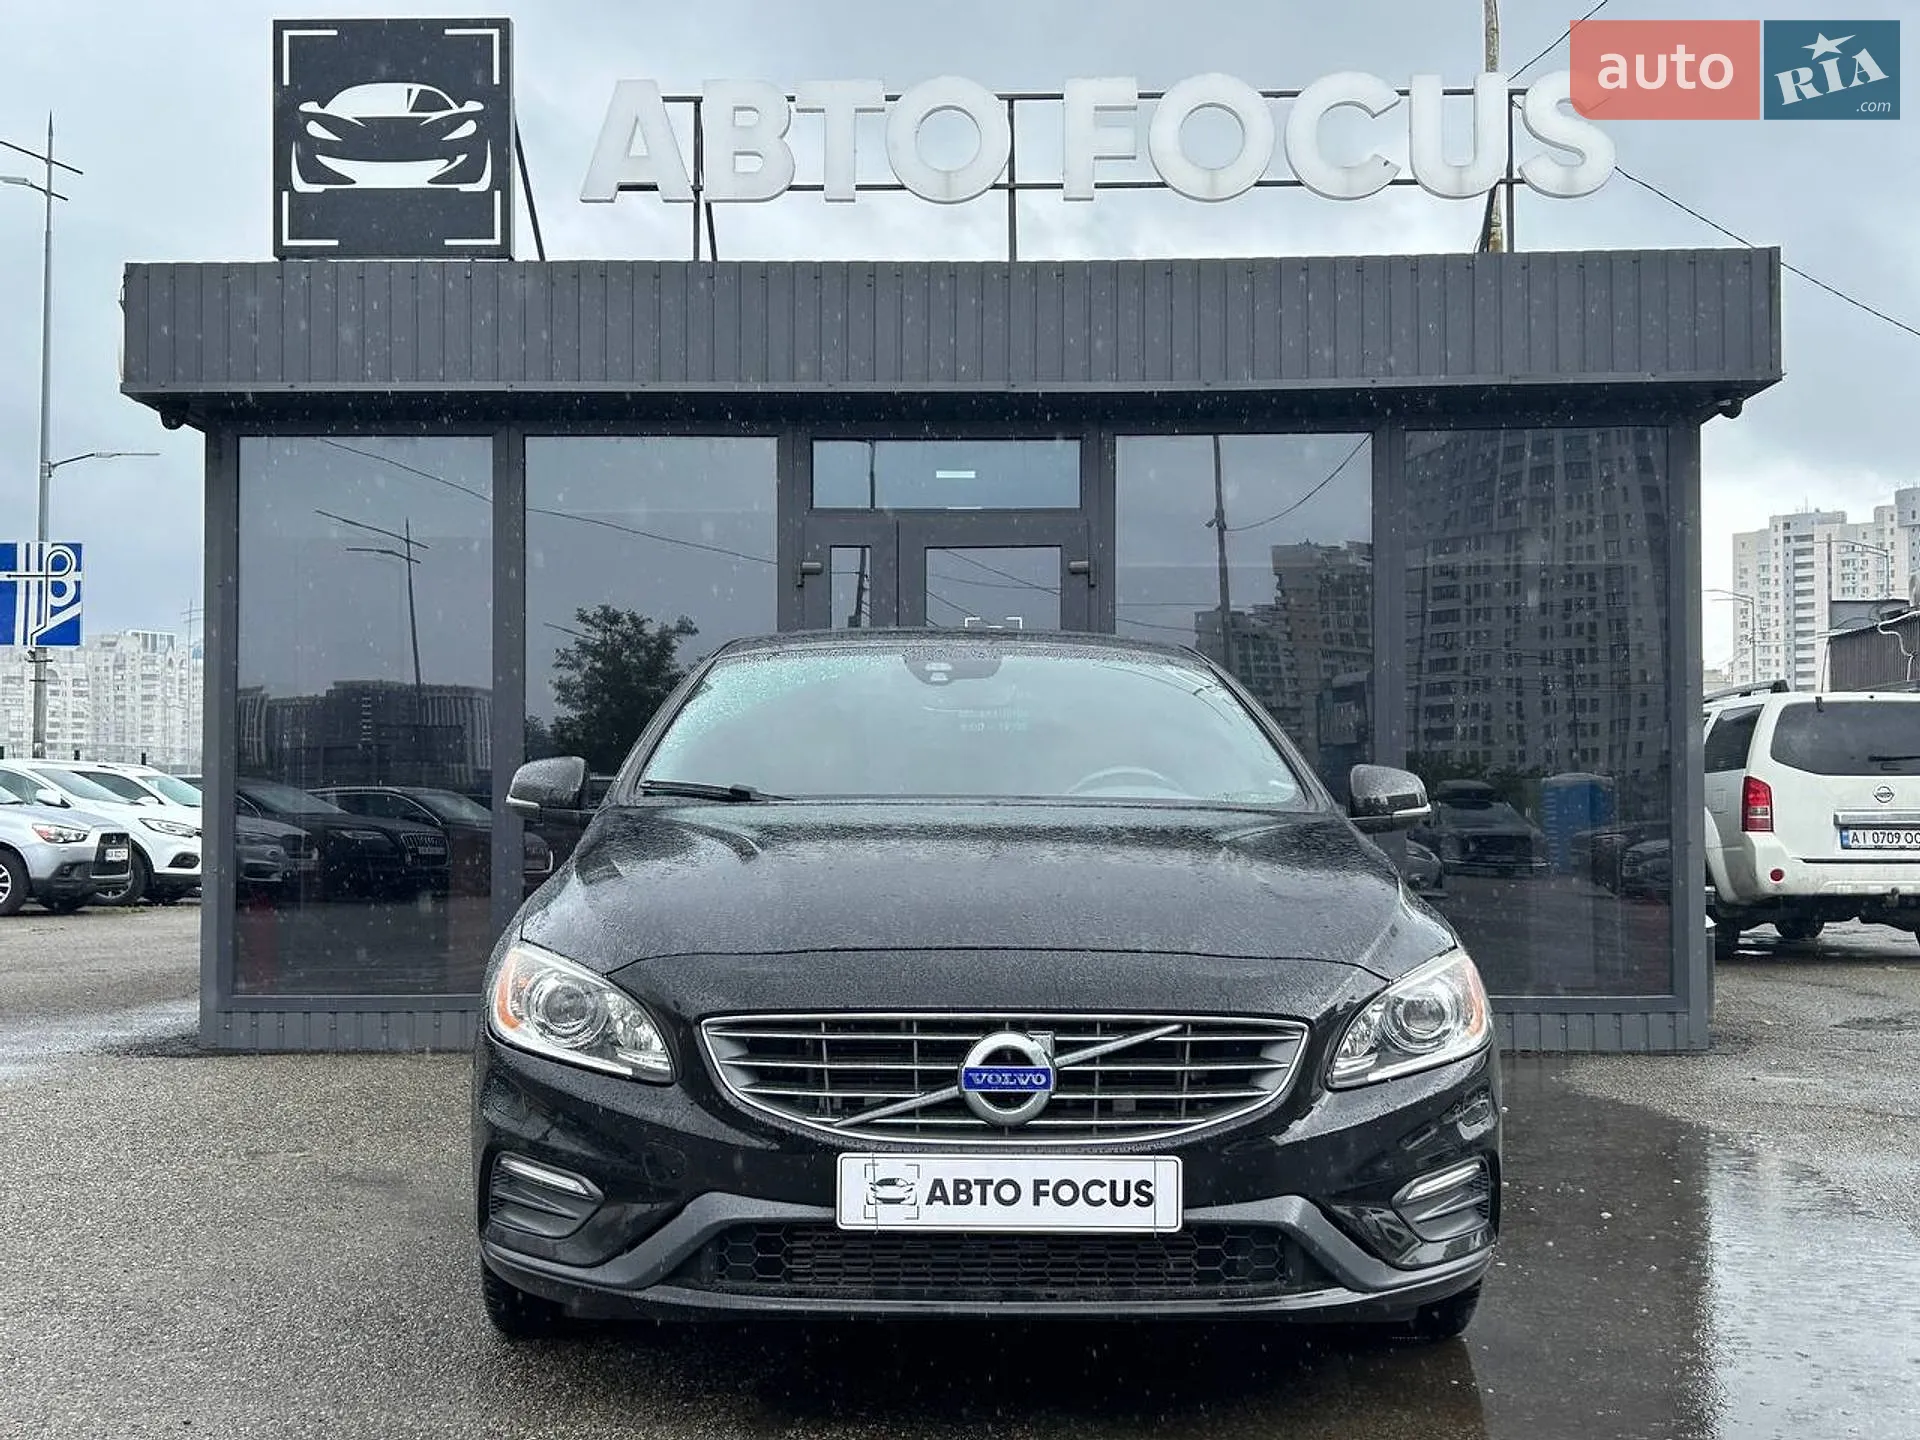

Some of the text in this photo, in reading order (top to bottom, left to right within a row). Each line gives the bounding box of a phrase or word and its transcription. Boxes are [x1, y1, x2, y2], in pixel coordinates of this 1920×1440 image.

[580, 72, 1617, 204] АВТО FOCUS
[1872, 832, 1901, 844] 0709
[969, 1073, 1047, 1086] VOLVO
[926, 1178, 1155, 1208] АВТО FOCUS
